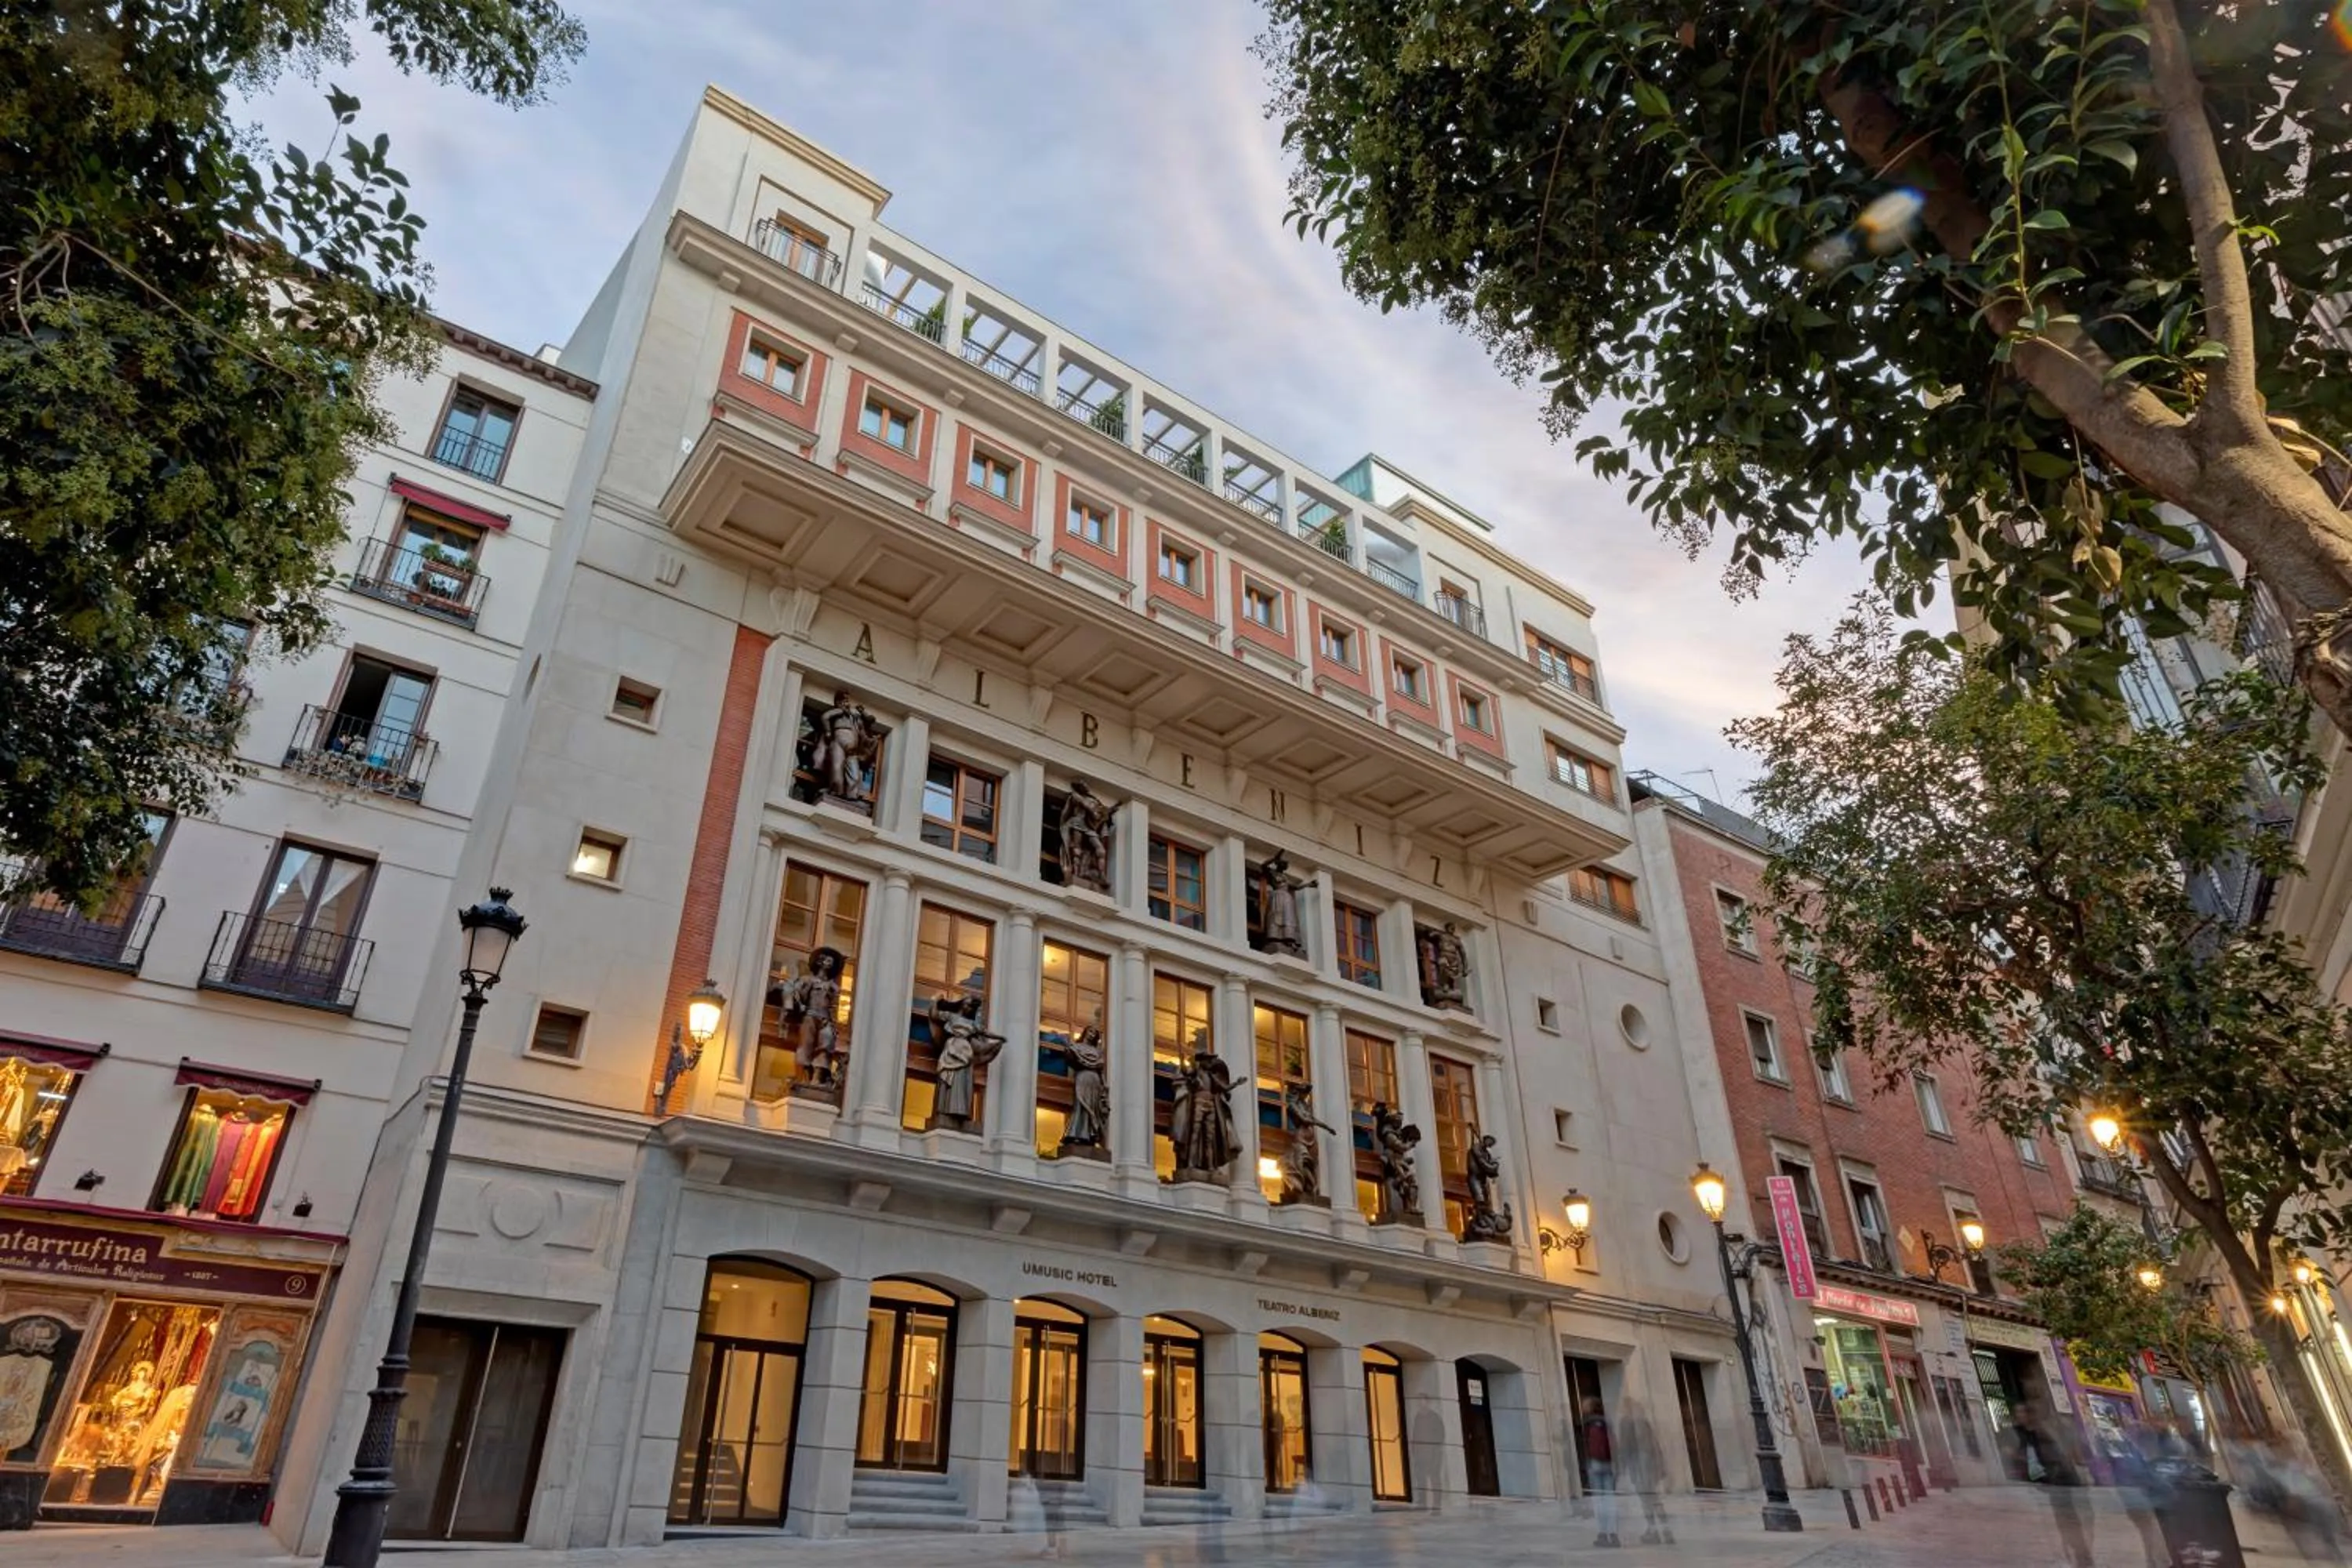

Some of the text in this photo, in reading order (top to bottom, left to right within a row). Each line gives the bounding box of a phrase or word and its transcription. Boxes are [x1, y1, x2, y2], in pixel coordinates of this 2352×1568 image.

[851, 622, 1444, 888] ALBENIZ
[1022, 1261, 1117, 1287] UMUSIC HOTEL
[291, 1278, 303, 1292] 9
[1257, 1299, 1297, 1314] TEATRO
